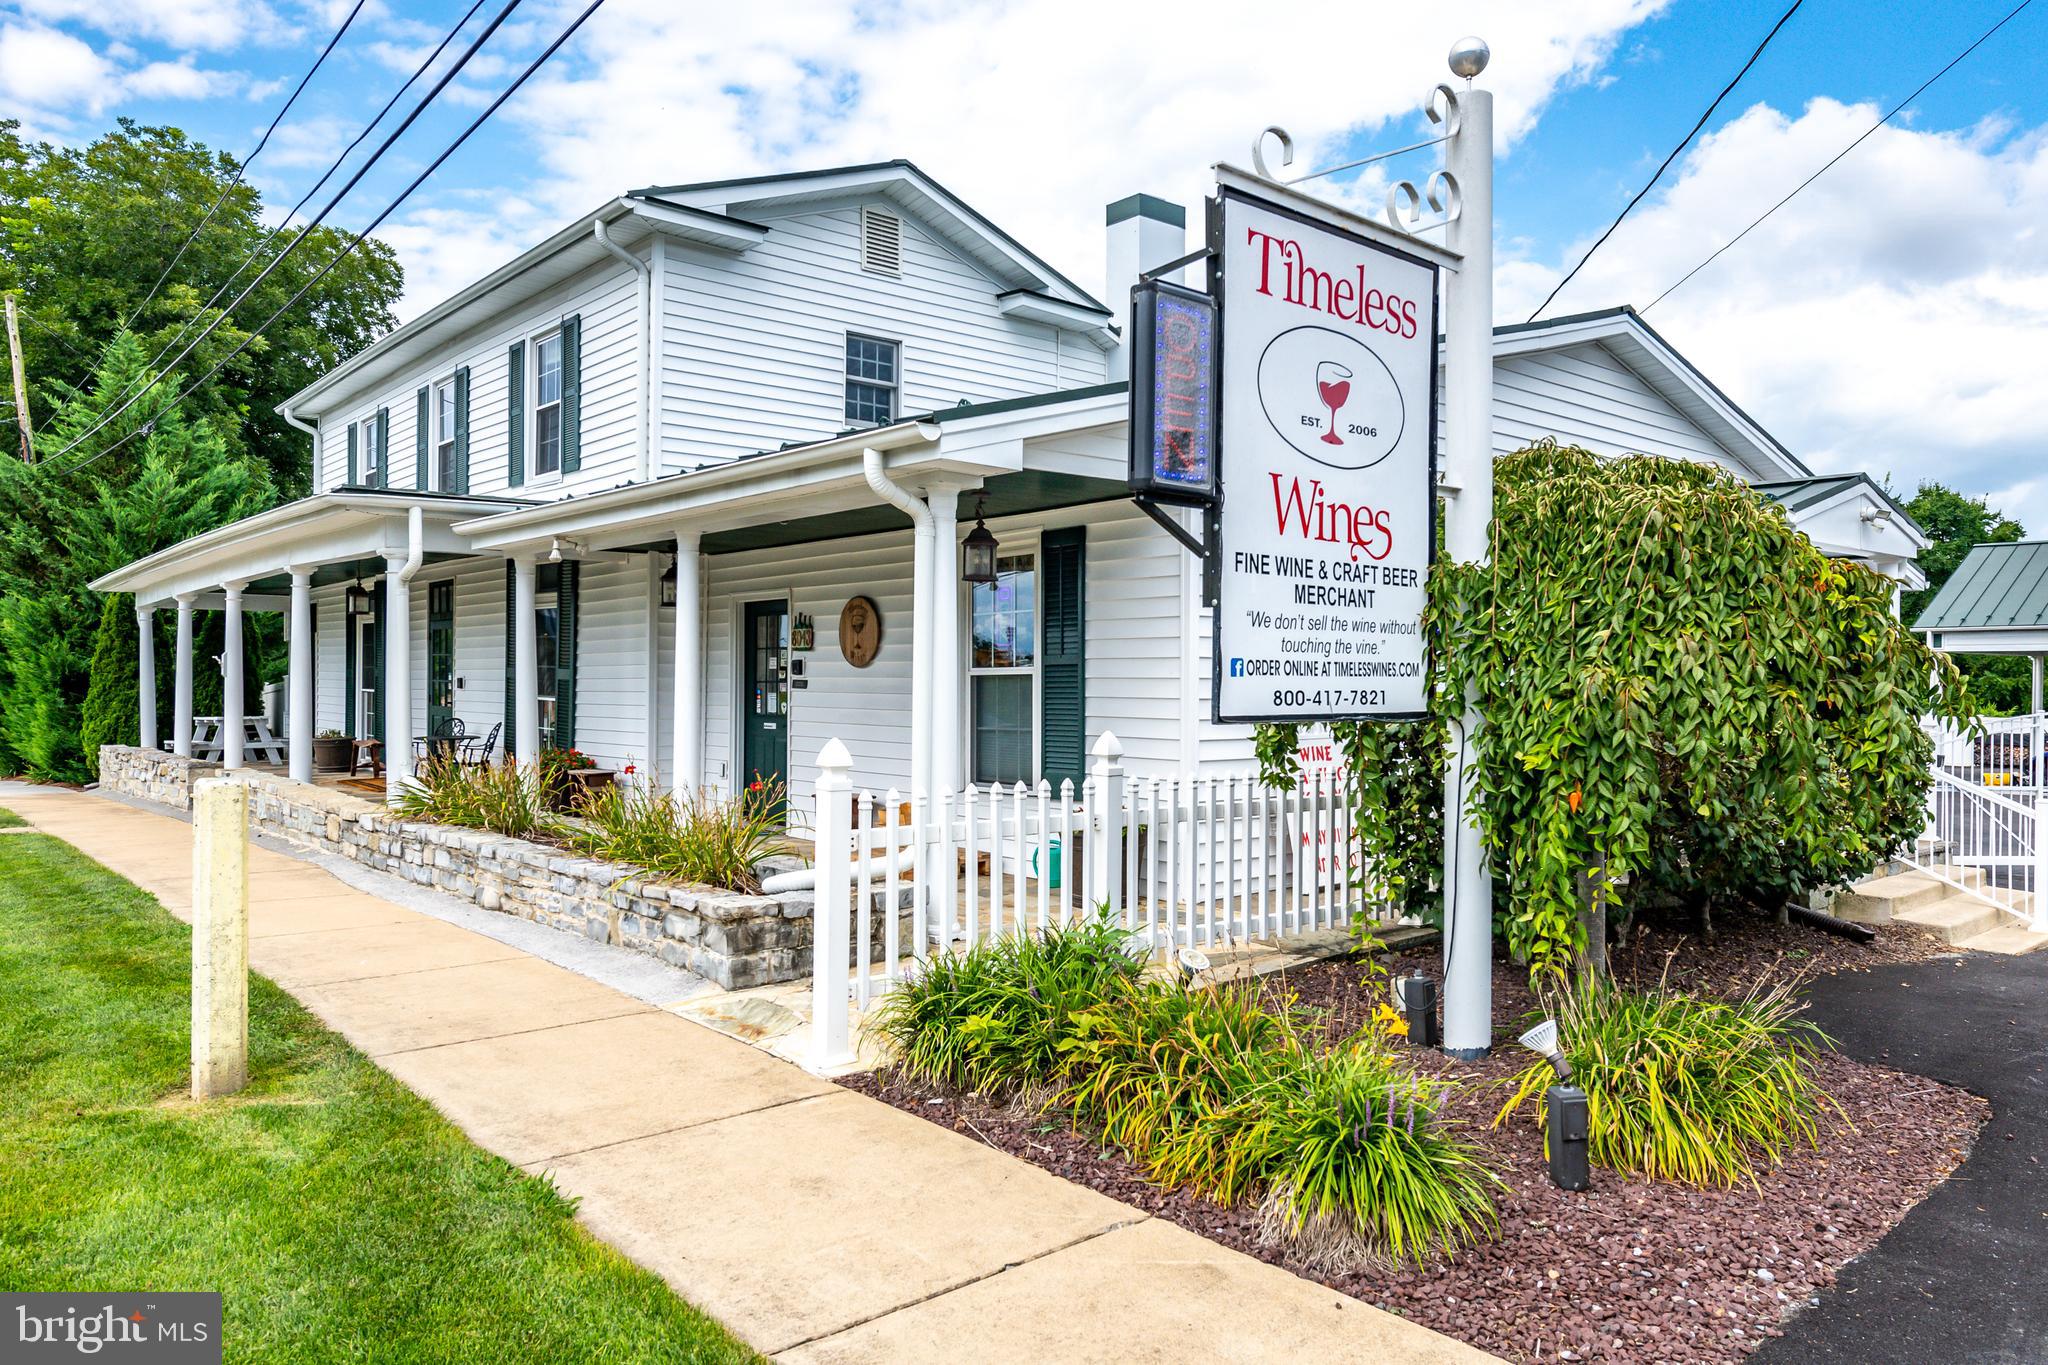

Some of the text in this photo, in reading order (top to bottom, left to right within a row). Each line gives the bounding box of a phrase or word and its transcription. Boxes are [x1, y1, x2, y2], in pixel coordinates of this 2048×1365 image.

[1248, 227, 1417, 339] Timeless
[1164, 314, 1197, 472] OPEN
[1301, 415, 1377, 437] EST. 2006
[1268, 472, 1393, 562] Wines
[1235, 552, 1418, 588] FINE WINE & CRAFT BEER
[1294, 584, 1375, 608] MERCHANT
[1274, 614, 1304, 631] don’t
[1307, 615, 1327, 631] sell
[1330, 616, 1348, 632] the
[1351, 619, 1376, 633] wine
[1379, 620, 1416, 635] without
[1281, 637, 1331, 658] touching
[1334, 639, 1352, 654] the
[1246, 659, 1281, 676] ORDER
[1283, 660, 1319, 677] ONLINE
[1320, 661, 1331, 677] AT
[1334, 661, 1420, 677] TIMELESSWINES.COM
[1273, 690, 1386, 707] 800-417-7821
[1300, 745, 1332, 762] WINE
